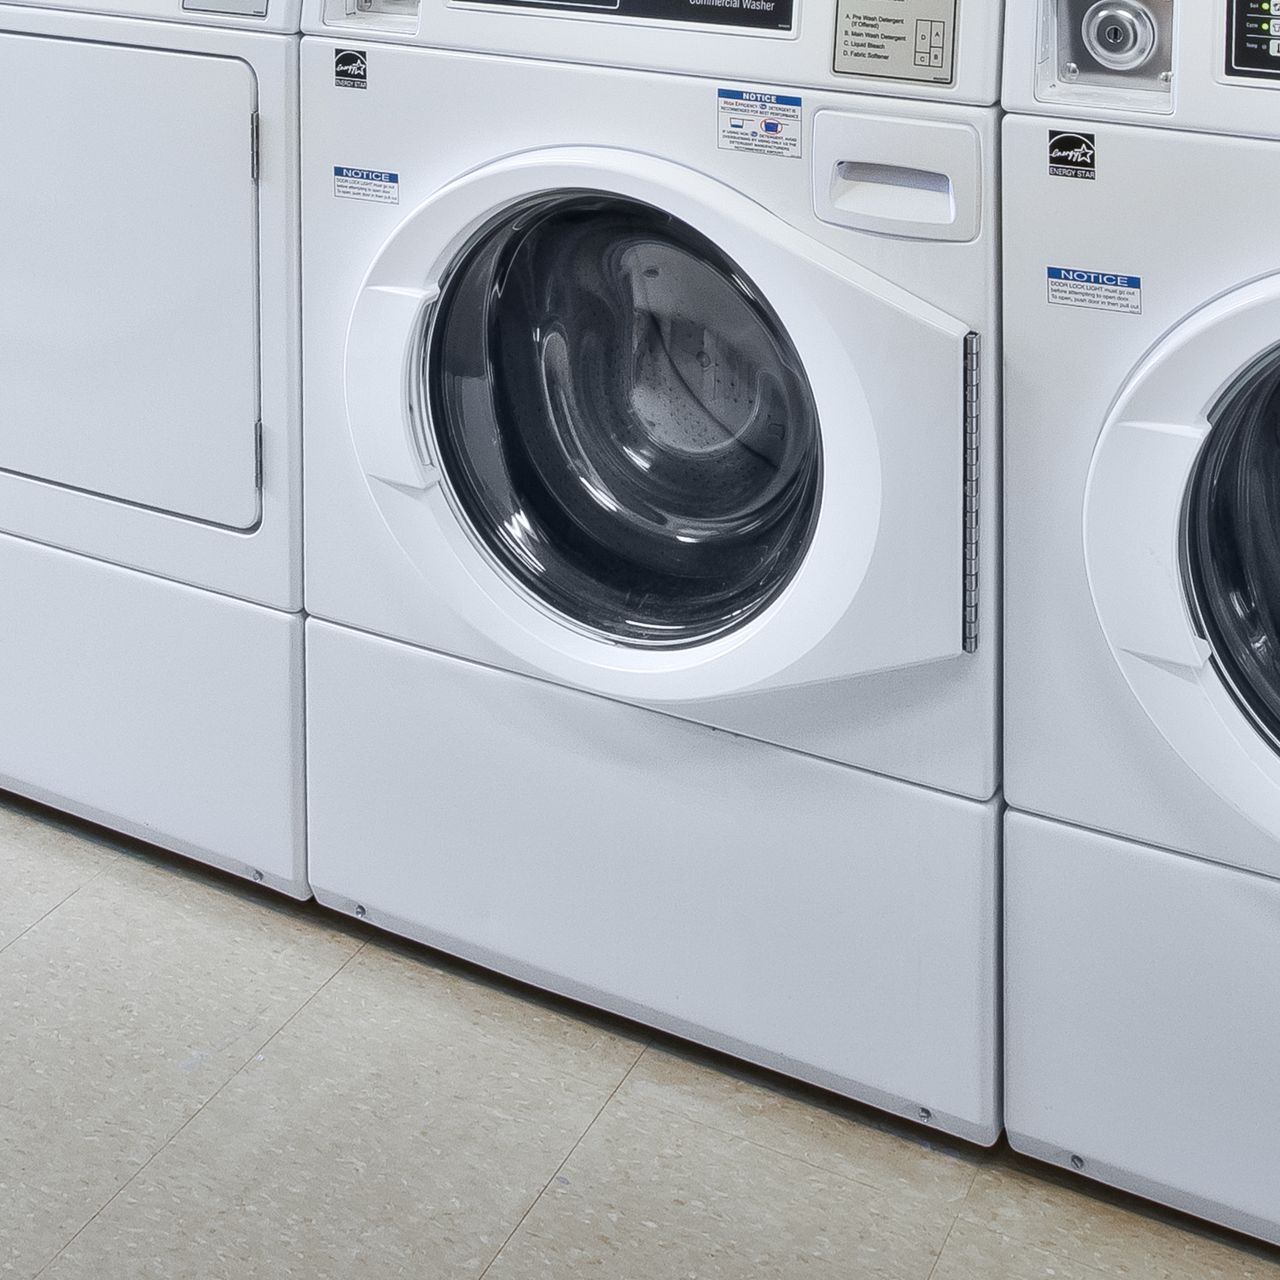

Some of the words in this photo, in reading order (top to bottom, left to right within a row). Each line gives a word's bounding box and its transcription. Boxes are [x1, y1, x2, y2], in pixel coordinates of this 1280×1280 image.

[868, 52, 889, 60] Softener
[743, 93, 776, 103] NOTICE
[343, 169, 389, 181] NOTICE
[1050, 167, 1076, 176] ENERGY
[1061, 270, 1128, 286] NOTICE
